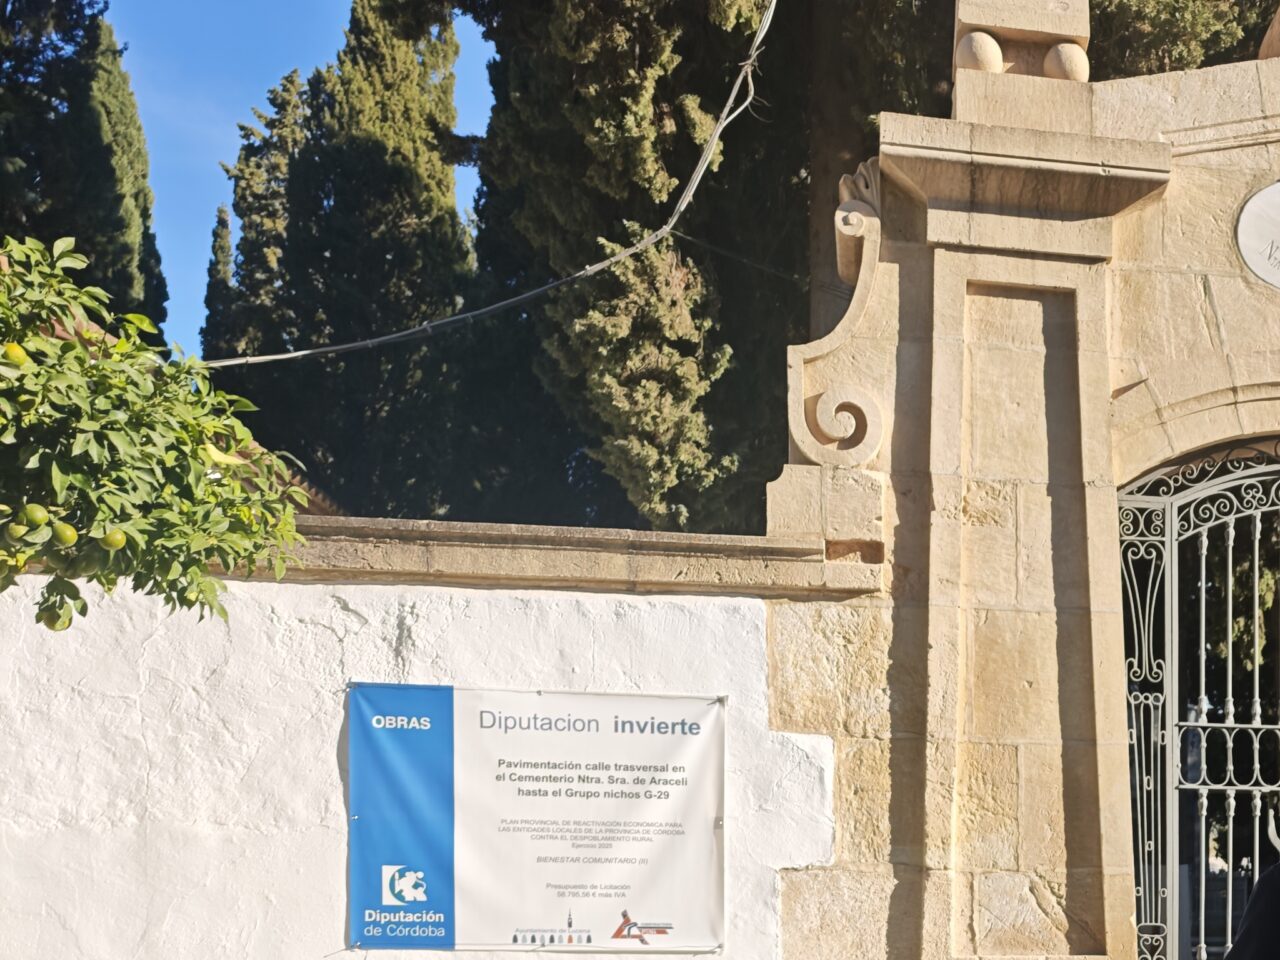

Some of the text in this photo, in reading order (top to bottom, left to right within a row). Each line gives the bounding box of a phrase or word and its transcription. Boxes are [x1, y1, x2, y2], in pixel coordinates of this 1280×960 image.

[372, 715, 431, 730] OBRAS
[479, 710, 701, 736] Diputacion invierte
[498, 759, 685, 773] Pavimentación calle trasversal en
[495, 773, 688, 786] el Cementerio Ntra. Sra. de Araceli
[518, 788, 670, 800] hasta el Grupo nichos G-29
[536, 856, 581, 864] BIENESTAR
[582, 856, 637, 865] COMUNITARIO
[546, 883, 588, 892] Presupuesto
[364, 909, 444, 924] Diputación
[364, 924, 445, 936] de Córdoba
